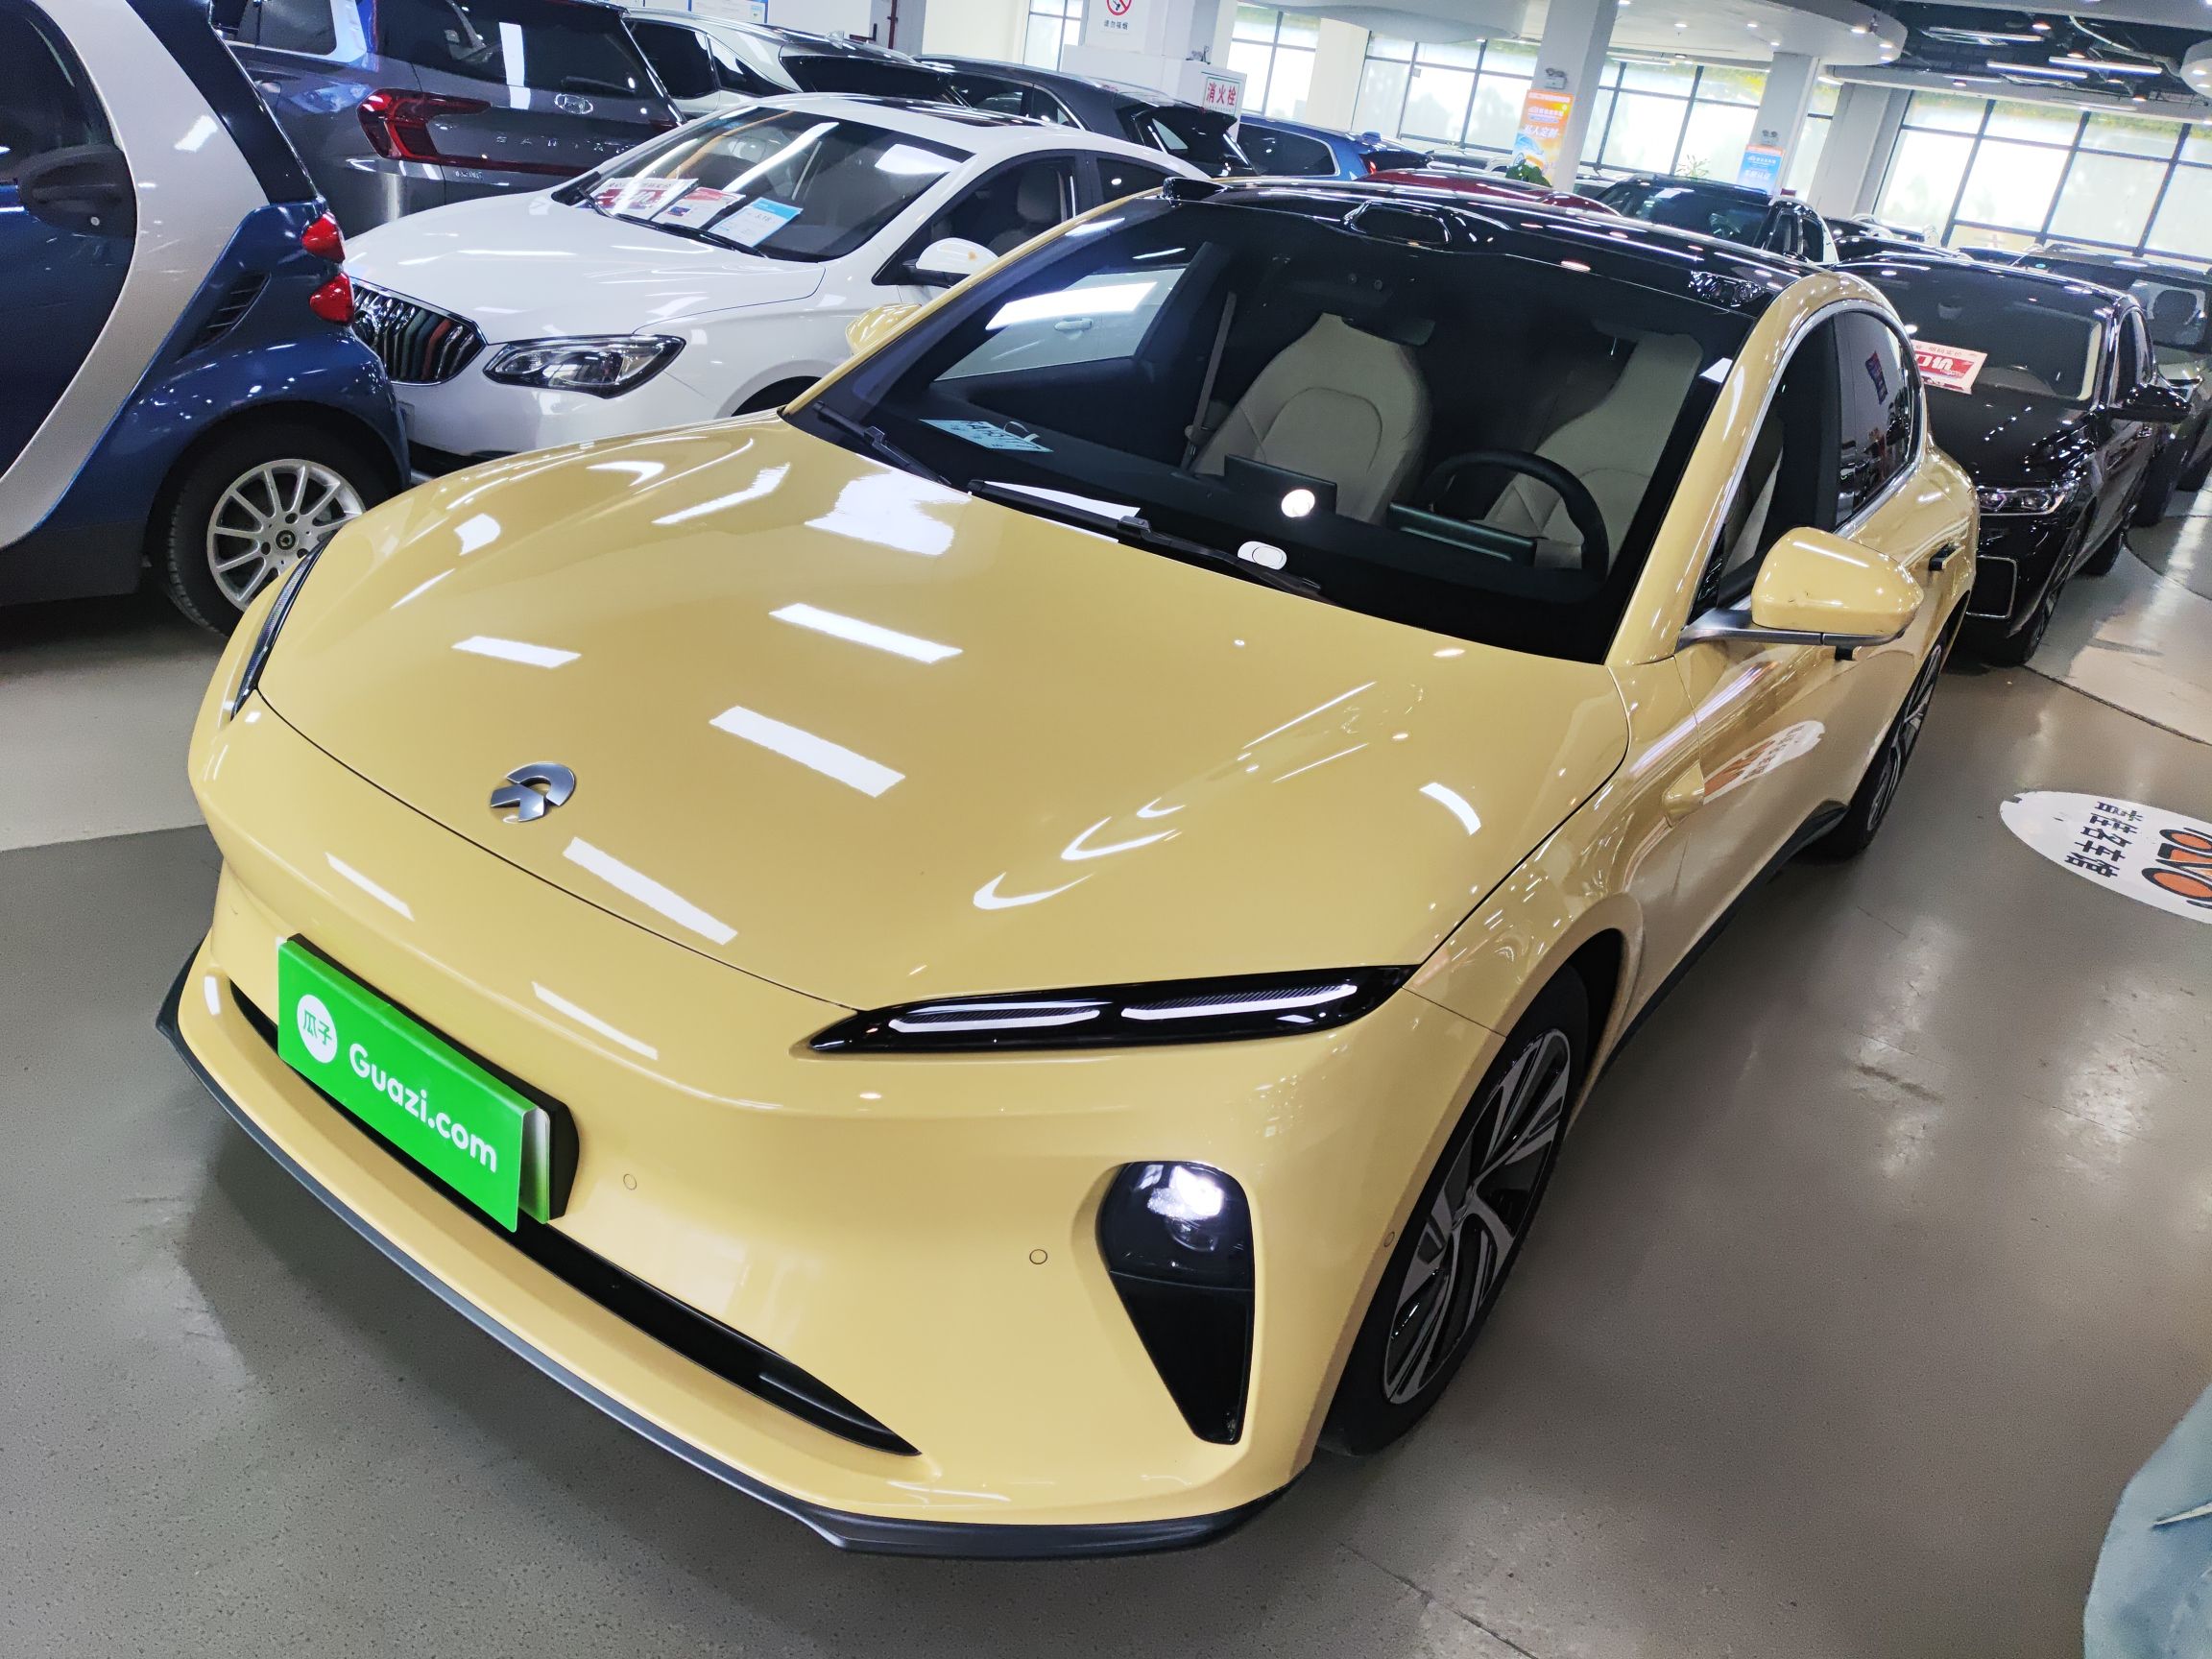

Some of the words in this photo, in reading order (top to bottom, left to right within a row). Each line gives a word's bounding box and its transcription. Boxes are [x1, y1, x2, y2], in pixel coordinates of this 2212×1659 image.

[1206, 82, 1238, 107] 消火栓
[2064, 801, 2144, 878] 首佳名车馆
[303, 1009, 332, 1046] 瓜子
[349, 1043, 497, 1173] Guazi.com
